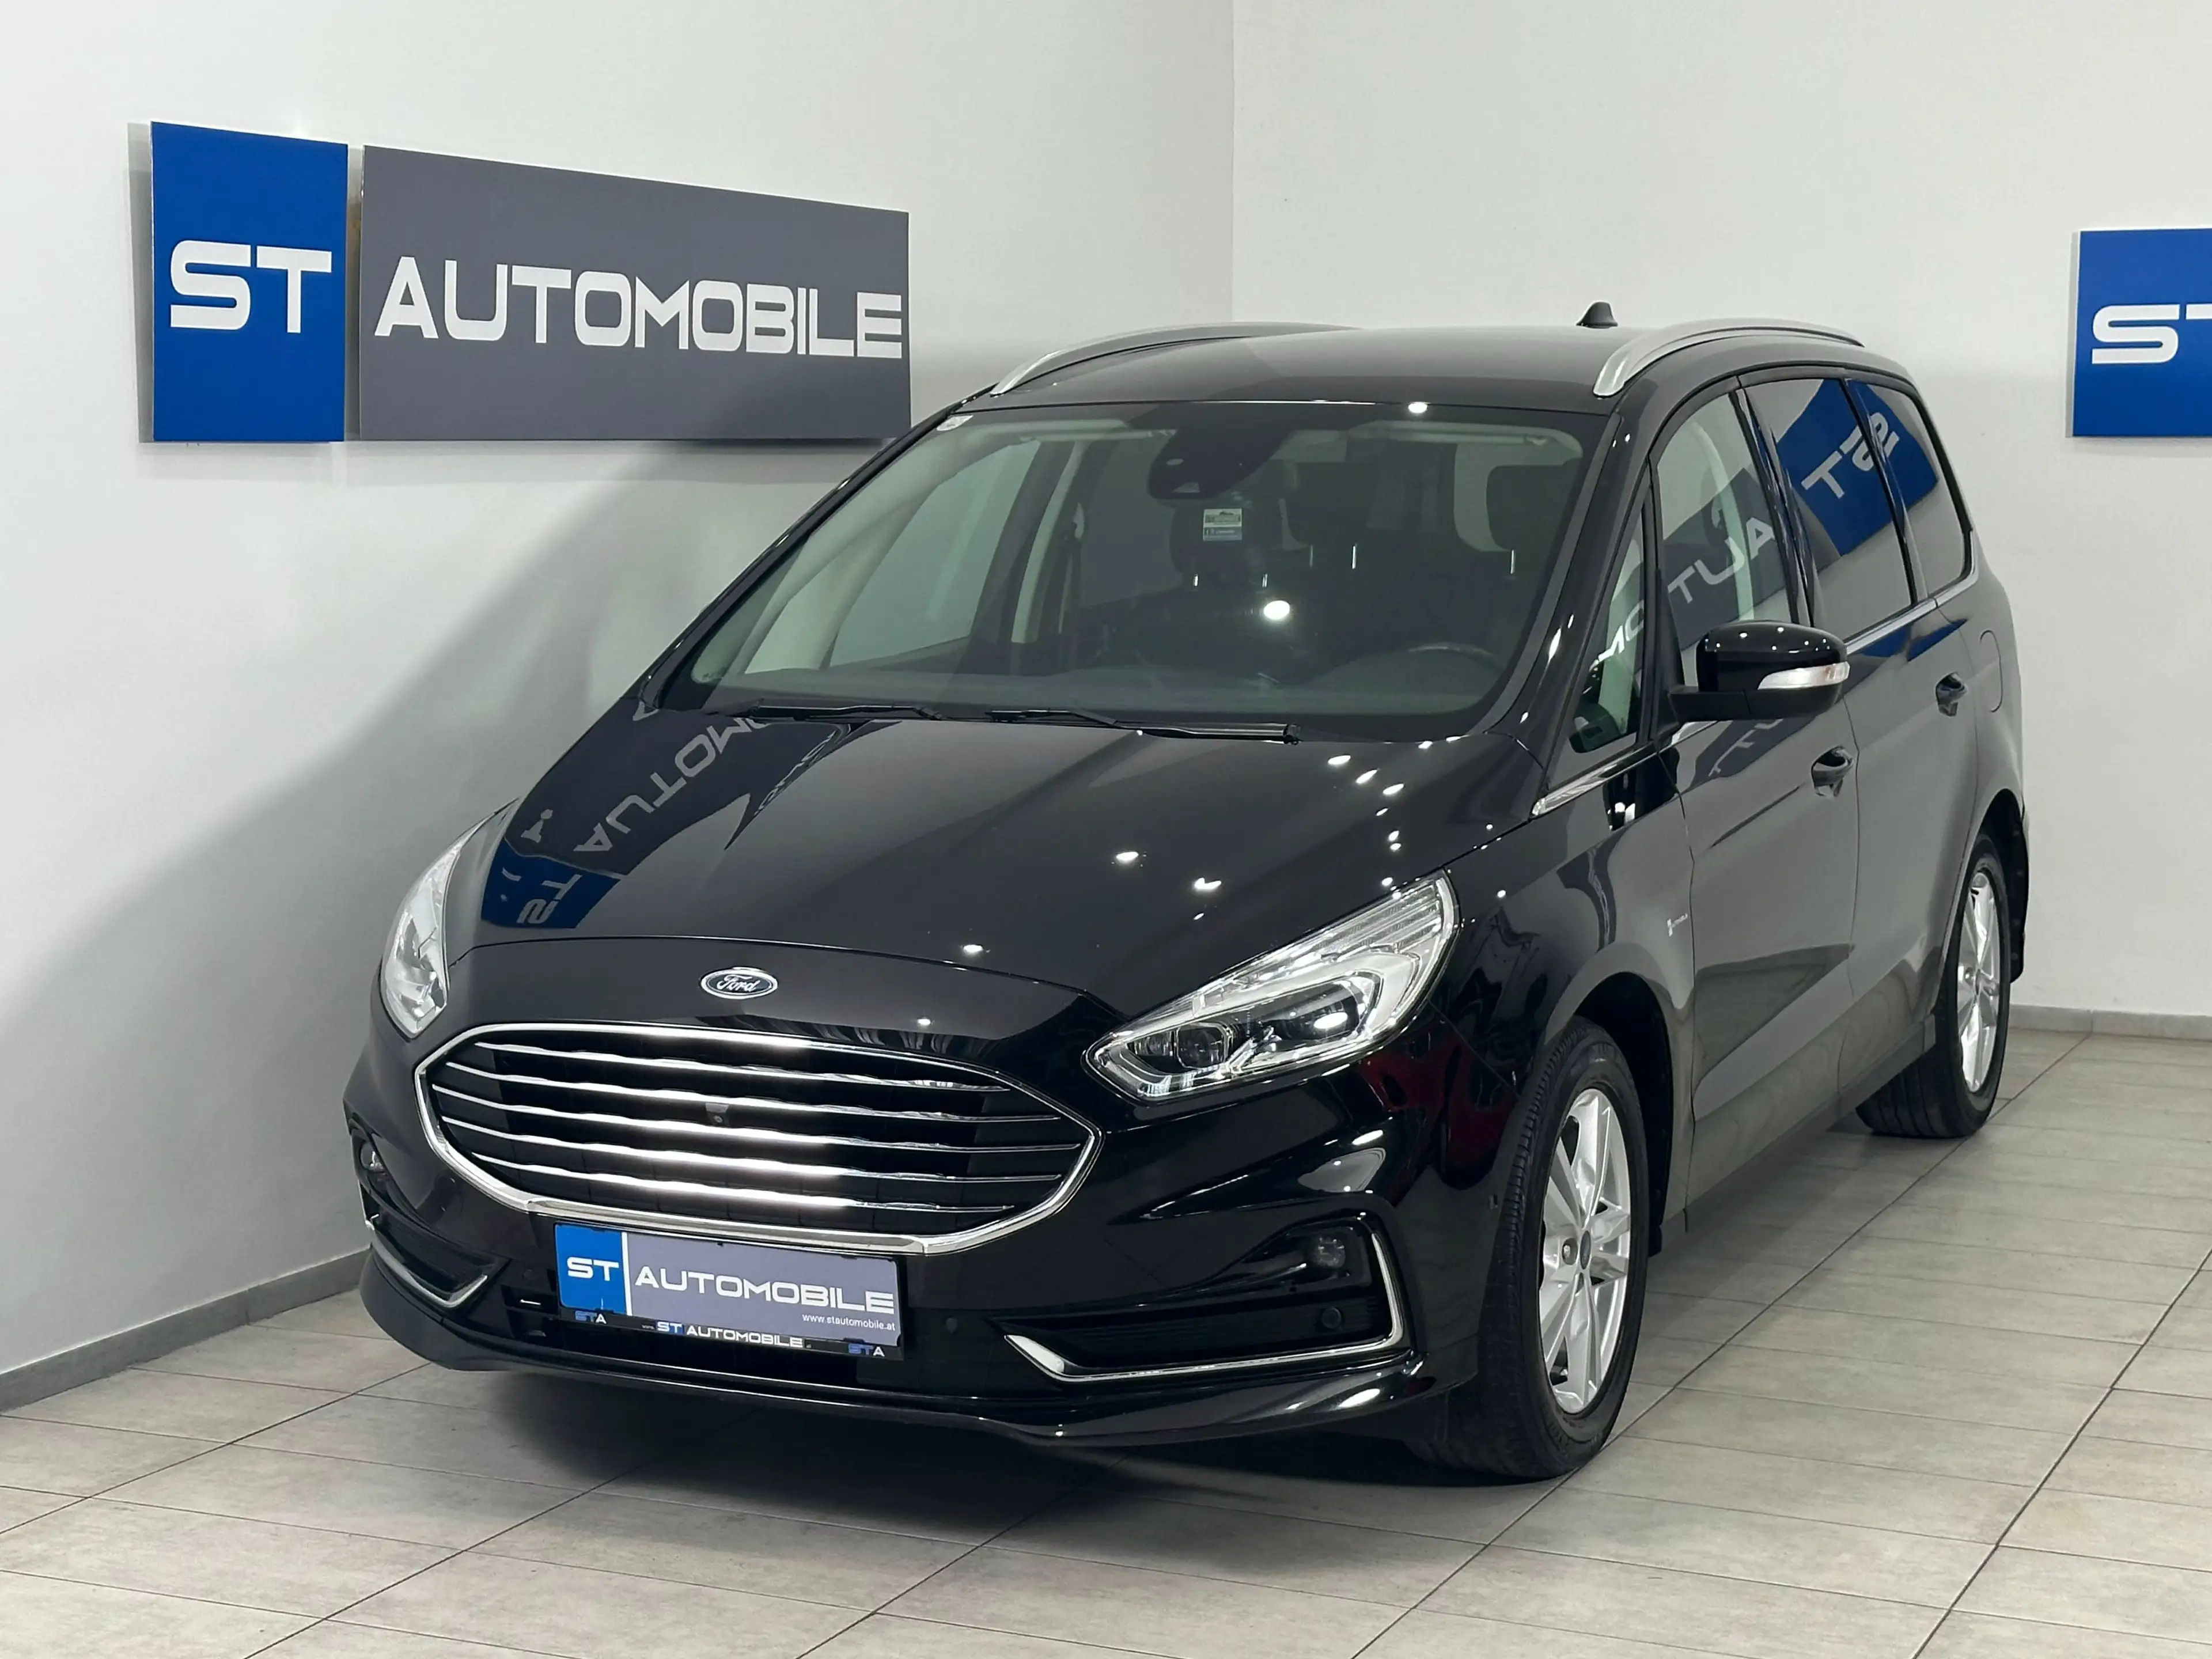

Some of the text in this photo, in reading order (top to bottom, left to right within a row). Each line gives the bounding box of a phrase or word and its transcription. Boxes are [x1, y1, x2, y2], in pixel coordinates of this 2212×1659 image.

[170, 240, 903, 359] ST AUTOMOBILE
[716, 974, 760, 992] Ford
[567, 1256, 895, 1315] ST AUTOMOBILE
[657, 1321, 803, 1348] ST AUTOMOBILE
[802, 1313, 895, 1331] www.stautomobile.at
